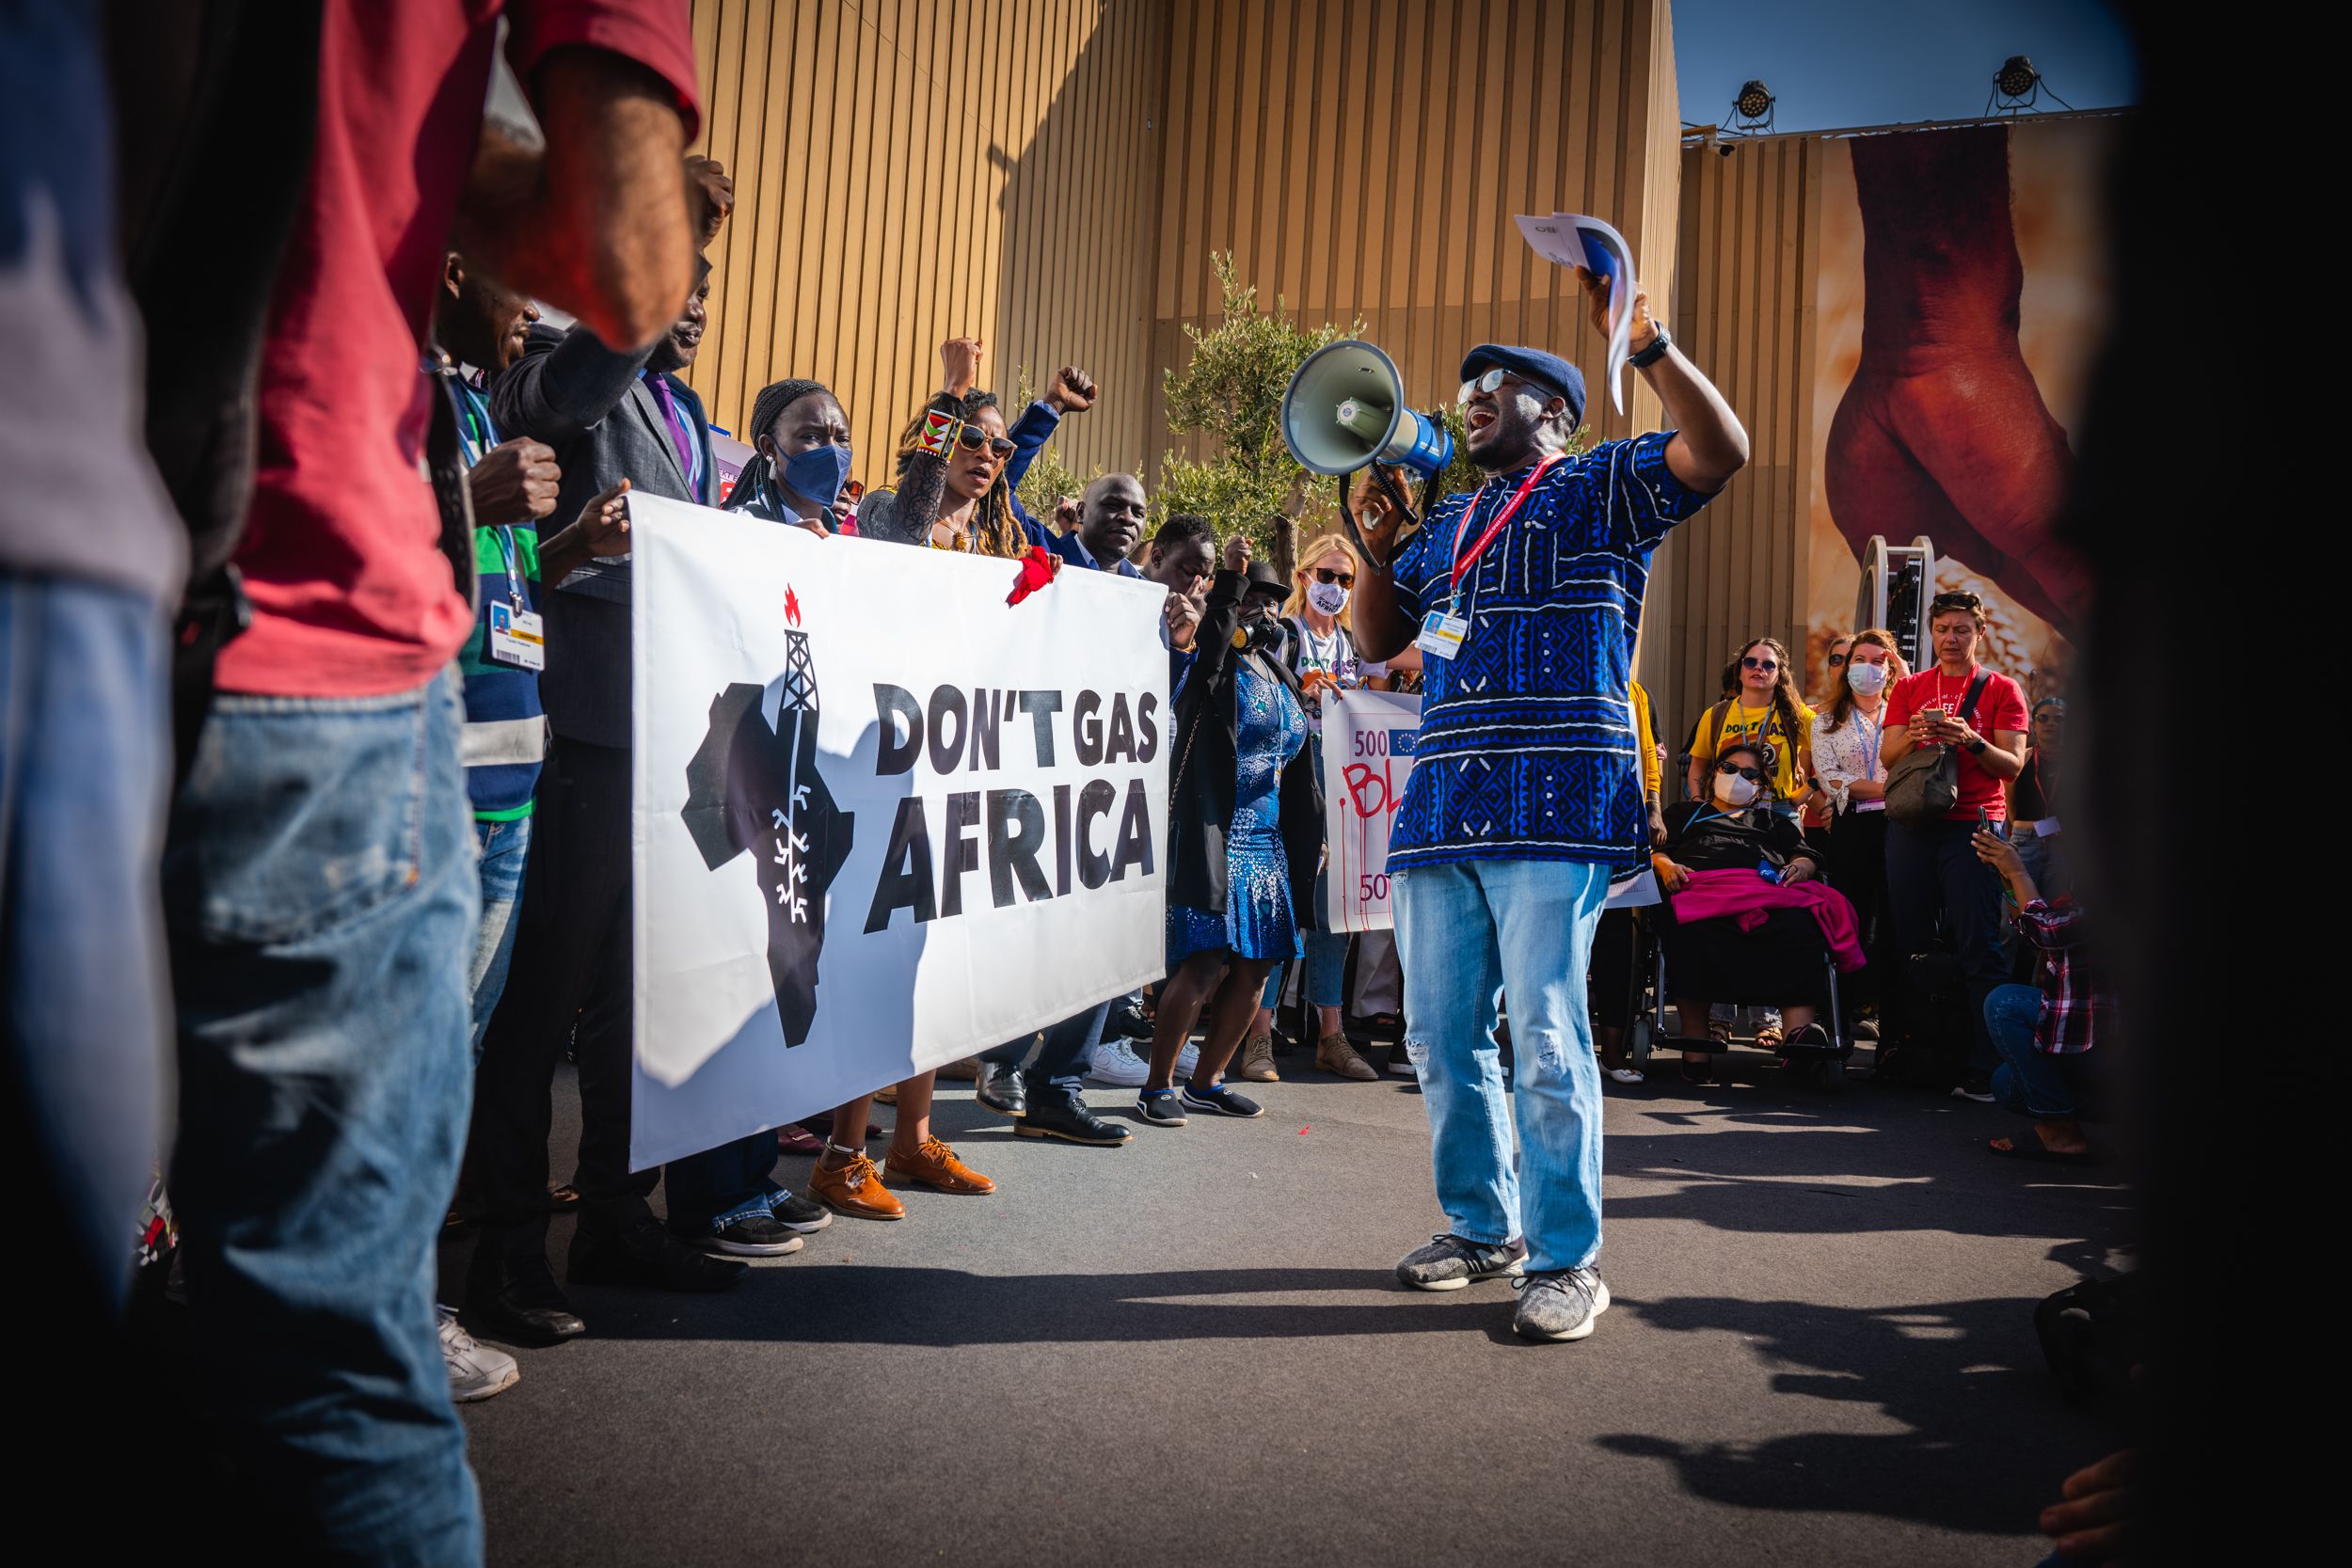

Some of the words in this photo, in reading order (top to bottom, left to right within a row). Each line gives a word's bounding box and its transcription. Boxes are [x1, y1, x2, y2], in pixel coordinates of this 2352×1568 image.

[873, 683, 1062, 776] DON'T
[1073, 689, 1158, 767] GAS
[1354, 730, 1388, 757] 500
[1343, 758, 1403, 818] BL
[864, 778, 1154, 935] AFRICA
[1360, 874, 1388, 901] 50
